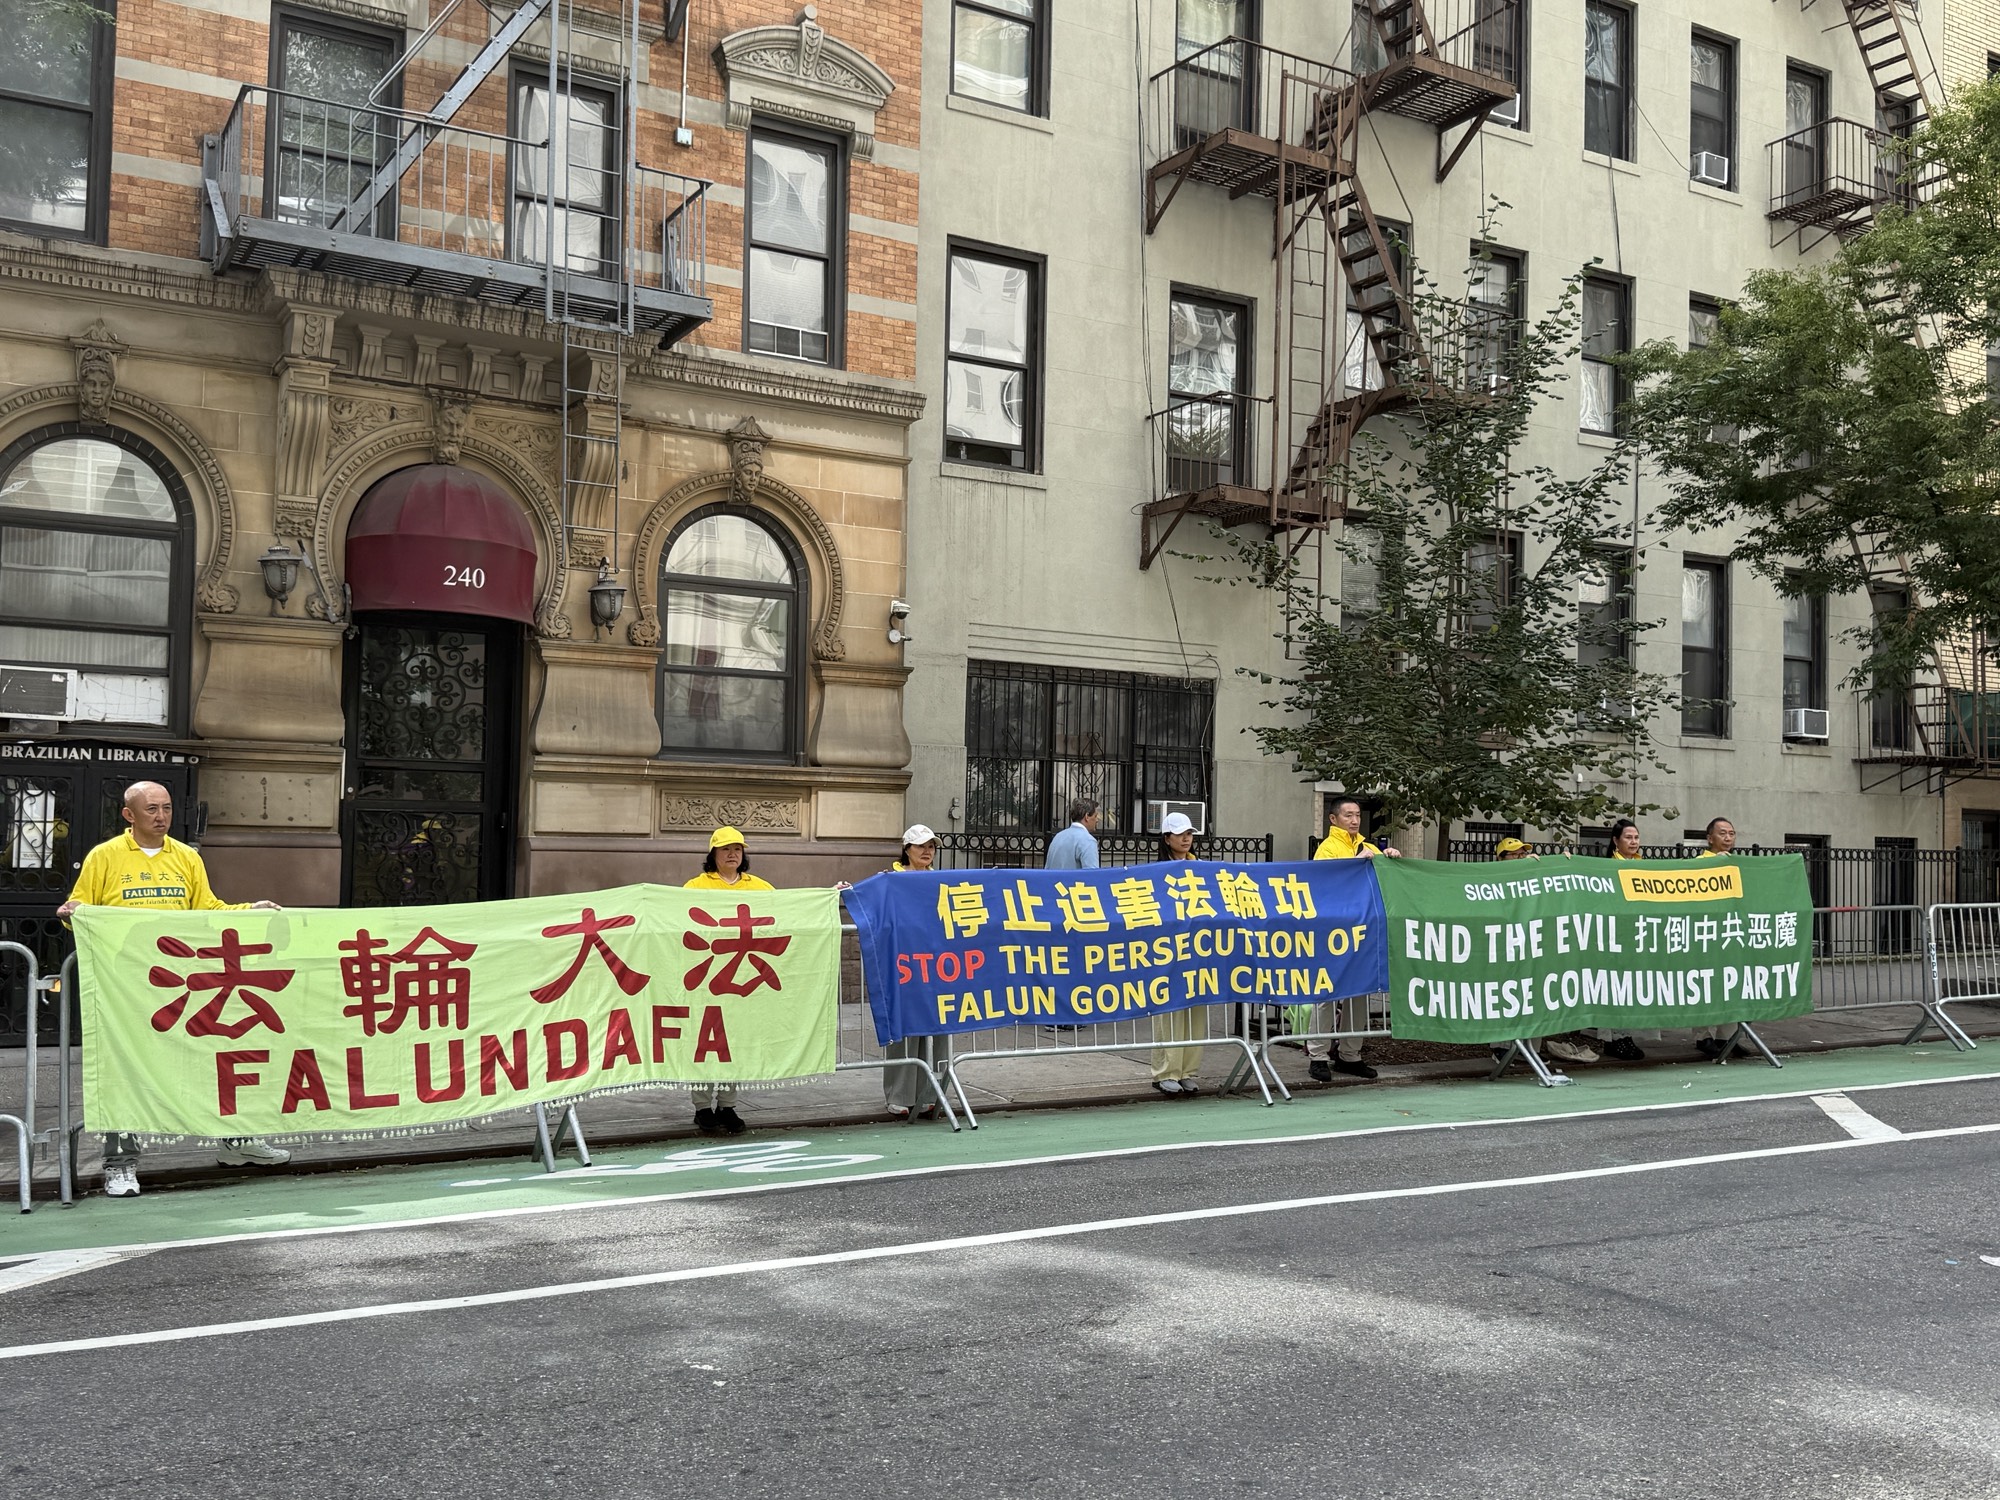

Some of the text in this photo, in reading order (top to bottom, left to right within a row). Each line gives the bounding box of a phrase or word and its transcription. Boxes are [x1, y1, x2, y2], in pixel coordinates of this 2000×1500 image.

[443, 565, 485, 588] 240
[2, 745, 168, 763] BRAZILIAN LIBRARY
[125, 887, 184, 899] FALUN DAFA
[937, 868, 1317, 940] 停止迫害法輪功
[1464, 874, 1616, 901] SIGN THE PETITION
[1631, 874, 1733, 894] ENDCCP.COM
[896, 924, 1368, 985] STOP THE PERSECUTION OF
[1405, 913, 1622, 964] END THE EVIL
[1634, 911, 1798, 955] 打倒中共恶魔
[148, 903, 793, 1040] 法輪大法
[1929, 944, 1937, 979] NYPD
[937, 966, 1334, 1025] FALUN GONG IN CHINA
[1408, 961, 1800, 1021] CHINESE COMMUNIST PARTY
